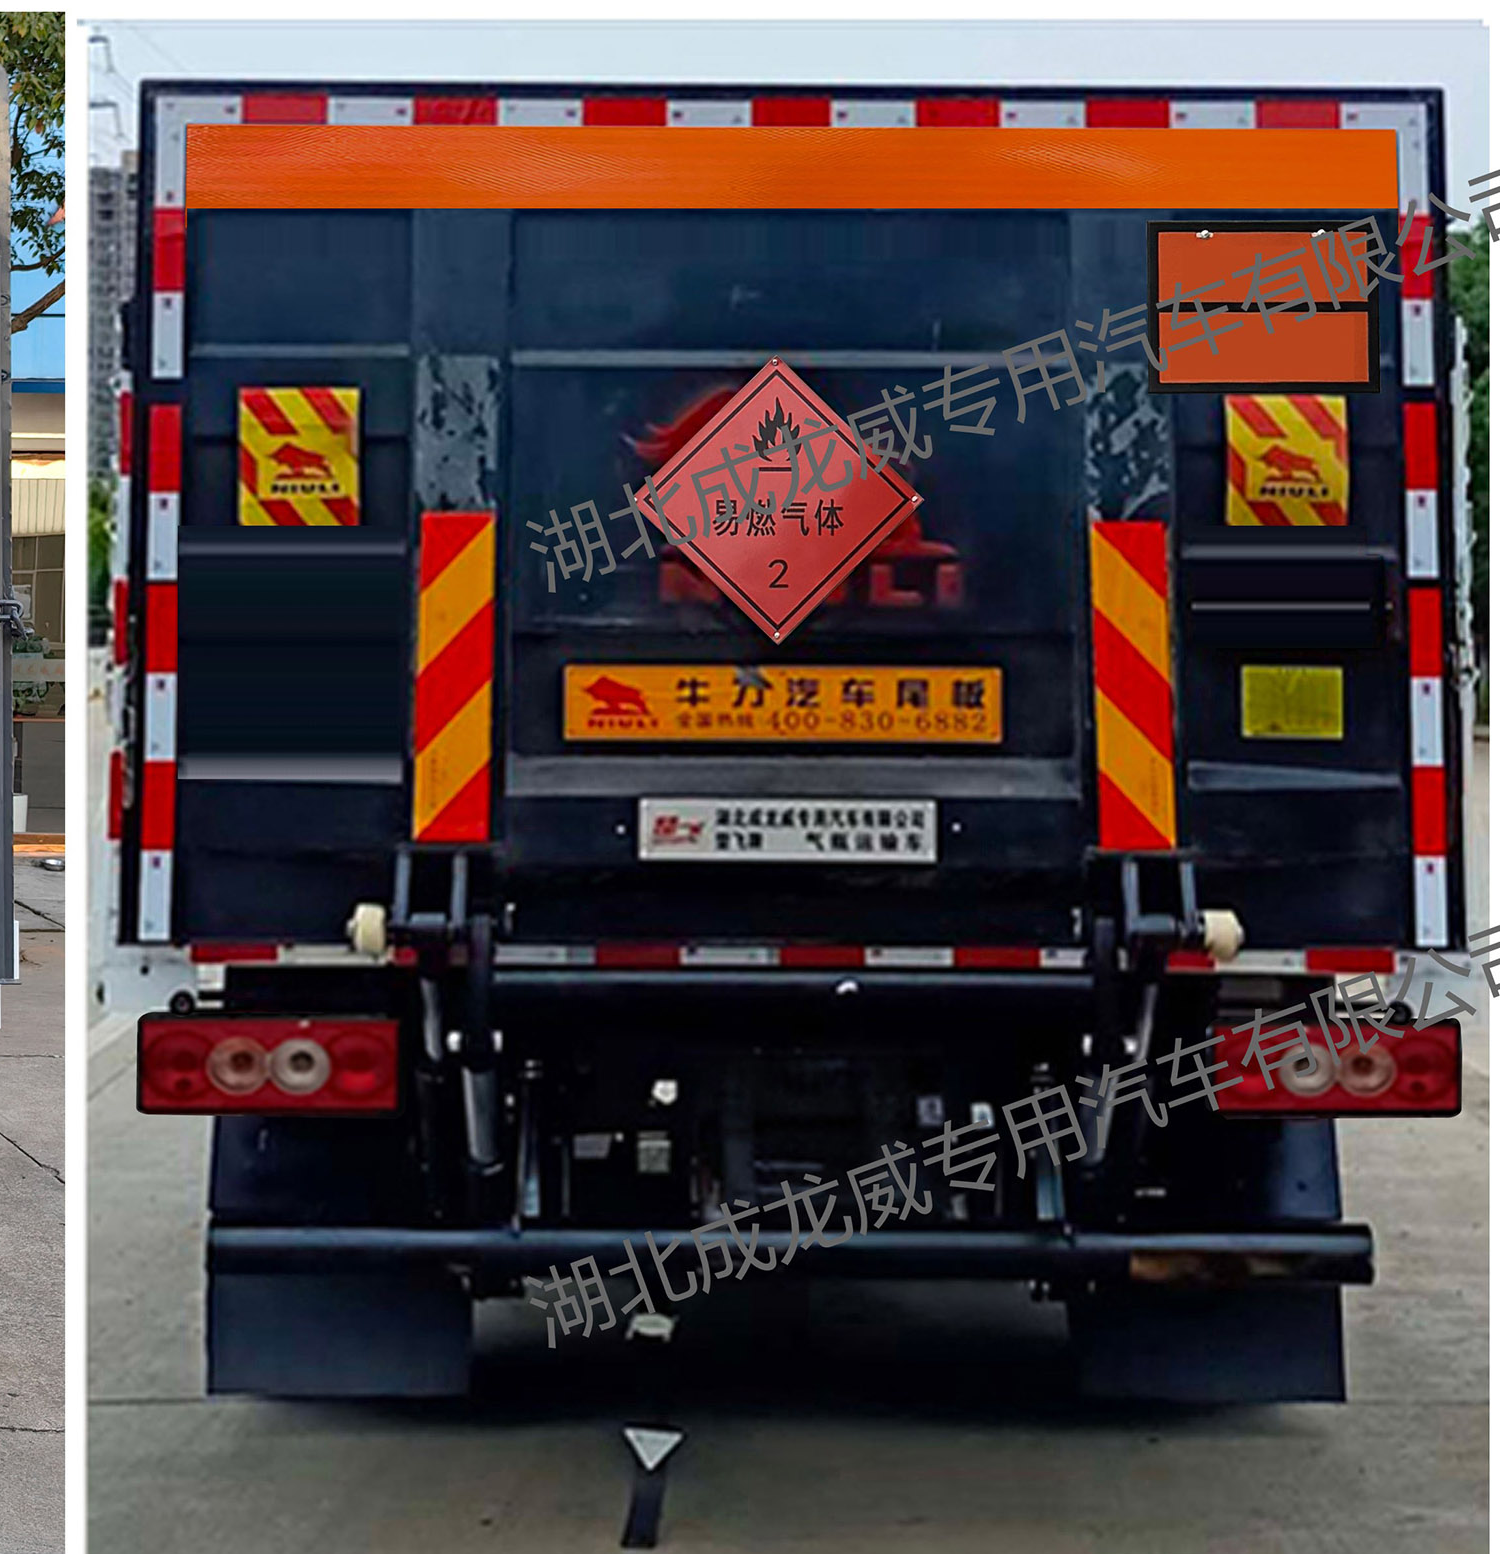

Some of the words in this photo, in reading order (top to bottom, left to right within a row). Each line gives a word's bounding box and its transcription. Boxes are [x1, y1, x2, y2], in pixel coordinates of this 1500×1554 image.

[712, 498, 845, 537] 易燃气体
[768, 558, 789, 589] 2
